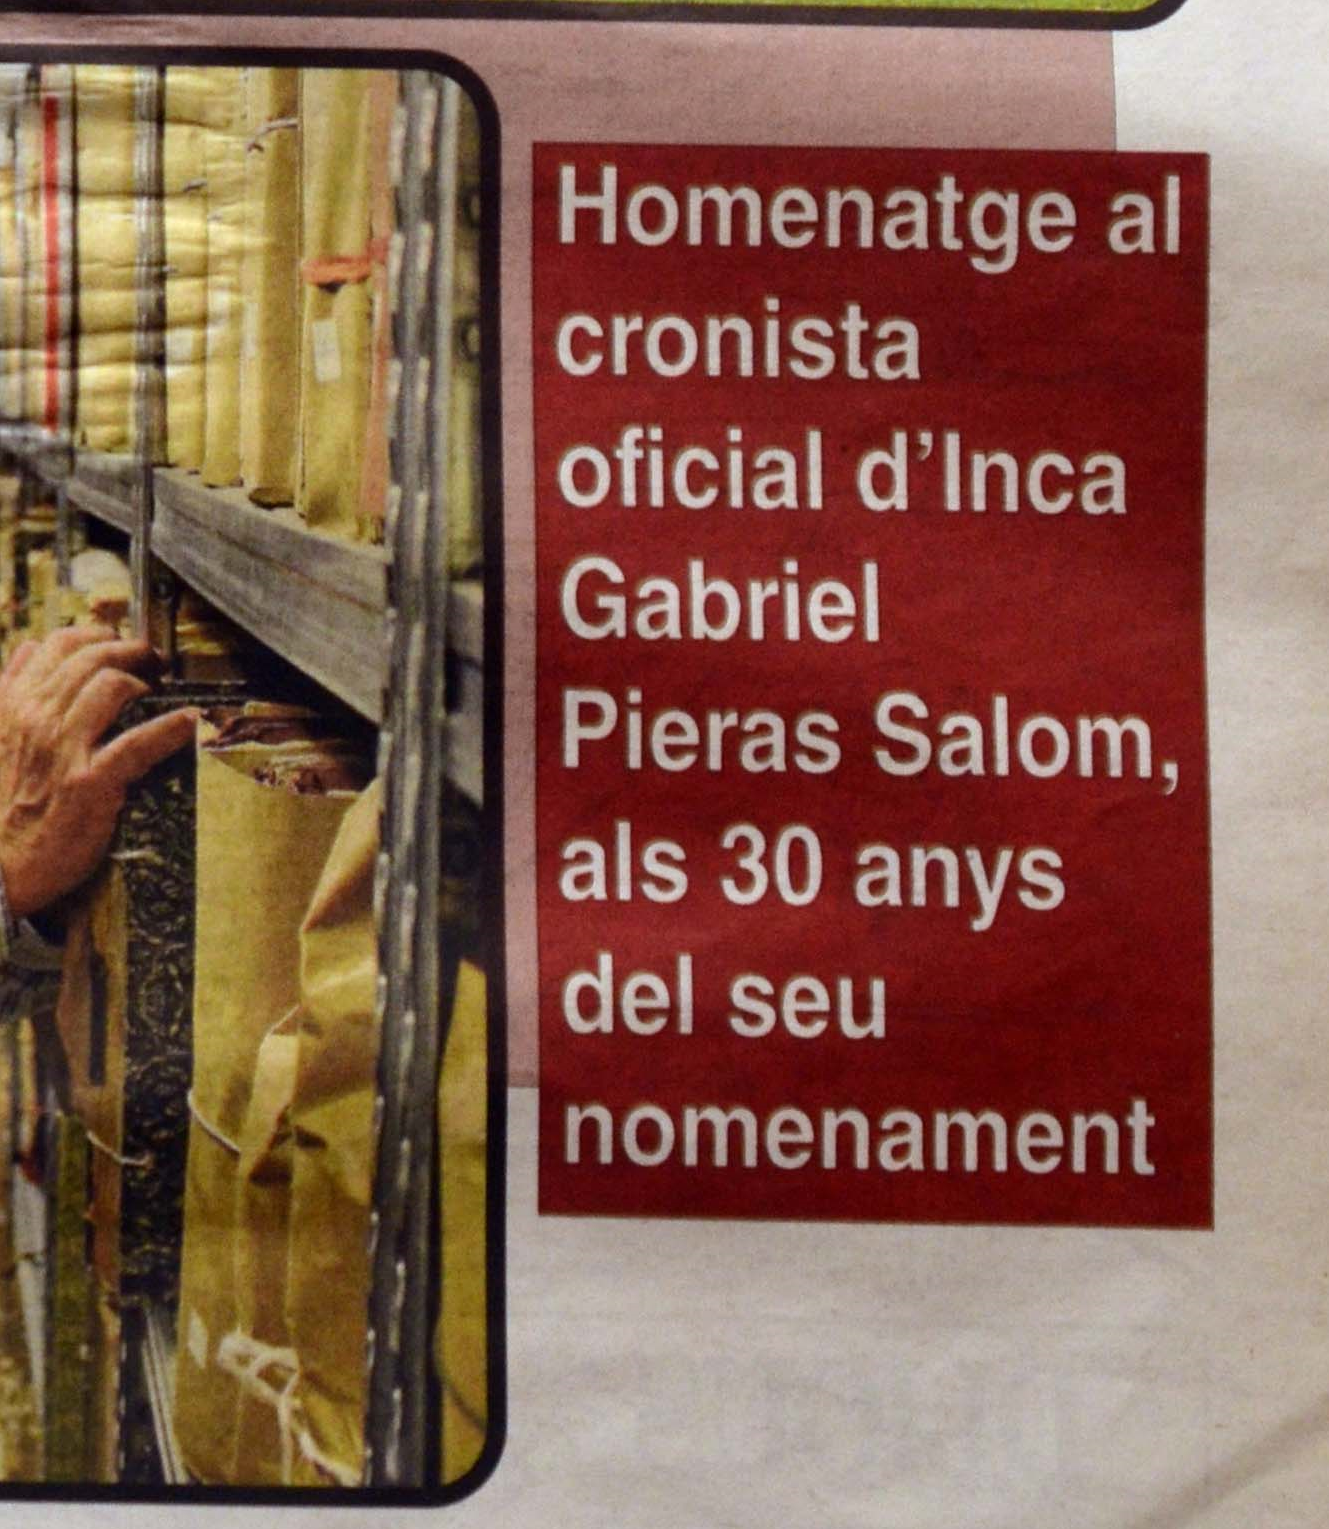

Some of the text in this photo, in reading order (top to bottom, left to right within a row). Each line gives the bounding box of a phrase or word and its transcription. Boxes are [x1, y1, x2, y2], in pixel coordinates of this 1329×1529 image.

[559, 164, 1181, 275] Homenatge al
[556, 298, 921, 381] cronista
[557, 425, 1127, 516] oficial d’Inca
[560, 555, 880, 644] Gabriel
[563, 688, 1179, 796] Pieras Salom,
[559, 820, 1066, 933] als 30 anys
[563, 950, 887, 1040] del seu
[565, 1100, 1156, 1175] nomenament
